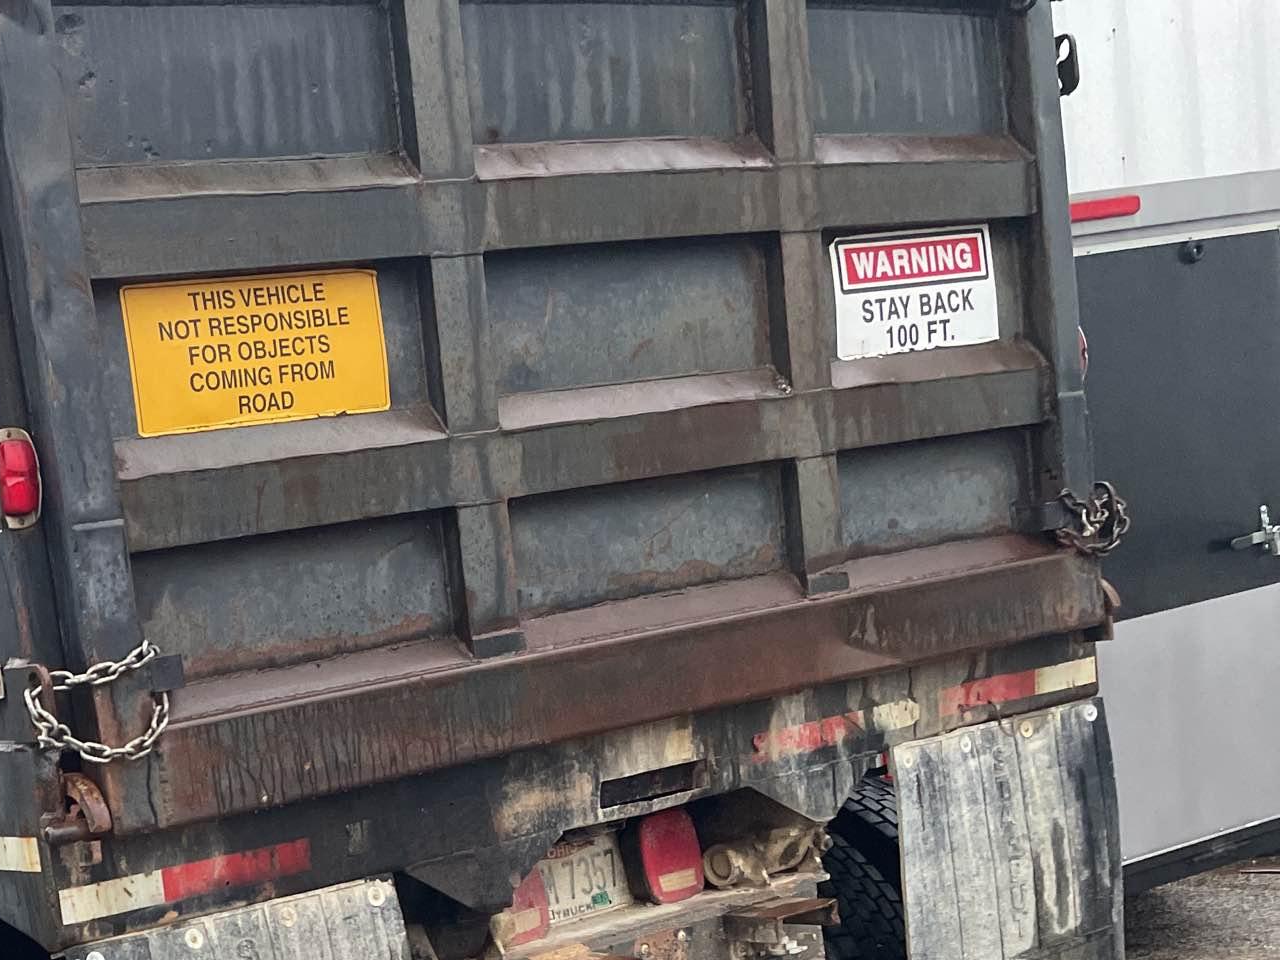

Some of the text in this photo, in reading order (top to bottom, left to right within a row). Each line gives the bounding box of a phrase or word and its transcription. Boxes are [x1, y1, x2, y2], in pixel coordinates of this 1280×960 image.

[850, 242, 973, 279] WARNING
[188, 283, 326, 311] THIS VEHICLE
[862, 288, 974, 323] STAY BACK
[158, 307, 350, 341] NOT RESPONSIBLE
[886, 319, 955, 348] 100 FT.
[188, 334, 330, 365] FOR OBJECTS
[189, 360, 335, 392] COMING FROM
[238, 391, 295, 414] ROAD
